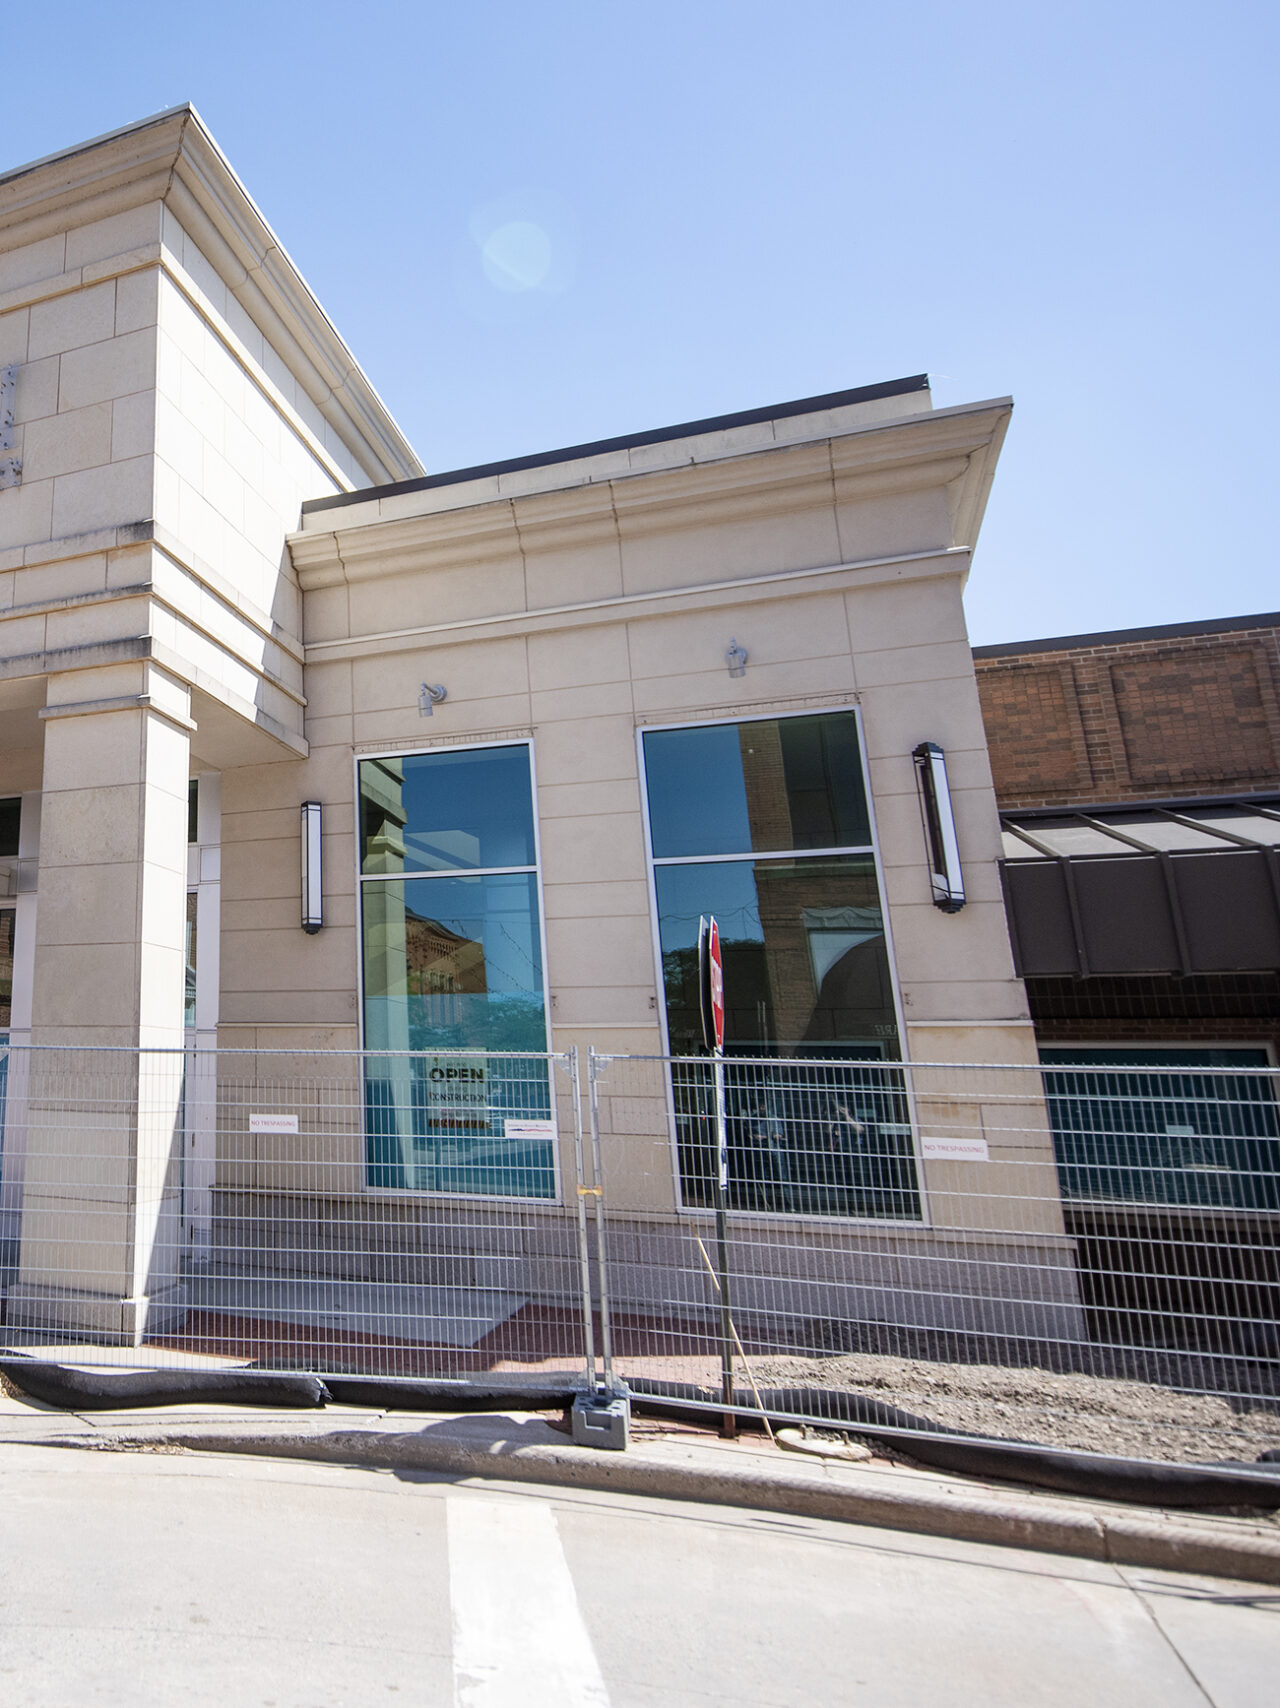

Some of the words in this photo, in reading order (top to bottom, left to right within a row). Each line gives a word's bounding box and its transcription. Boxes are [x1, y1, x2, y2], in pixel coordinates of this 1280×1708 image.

[429, 1067, 484, 1083] OPEN
[431, 1092, 488, 1102] CONSTRUCTION
[923, 1144, 936, 1152] NO
[937, 1145, 984, 1153] TRESPASSING
